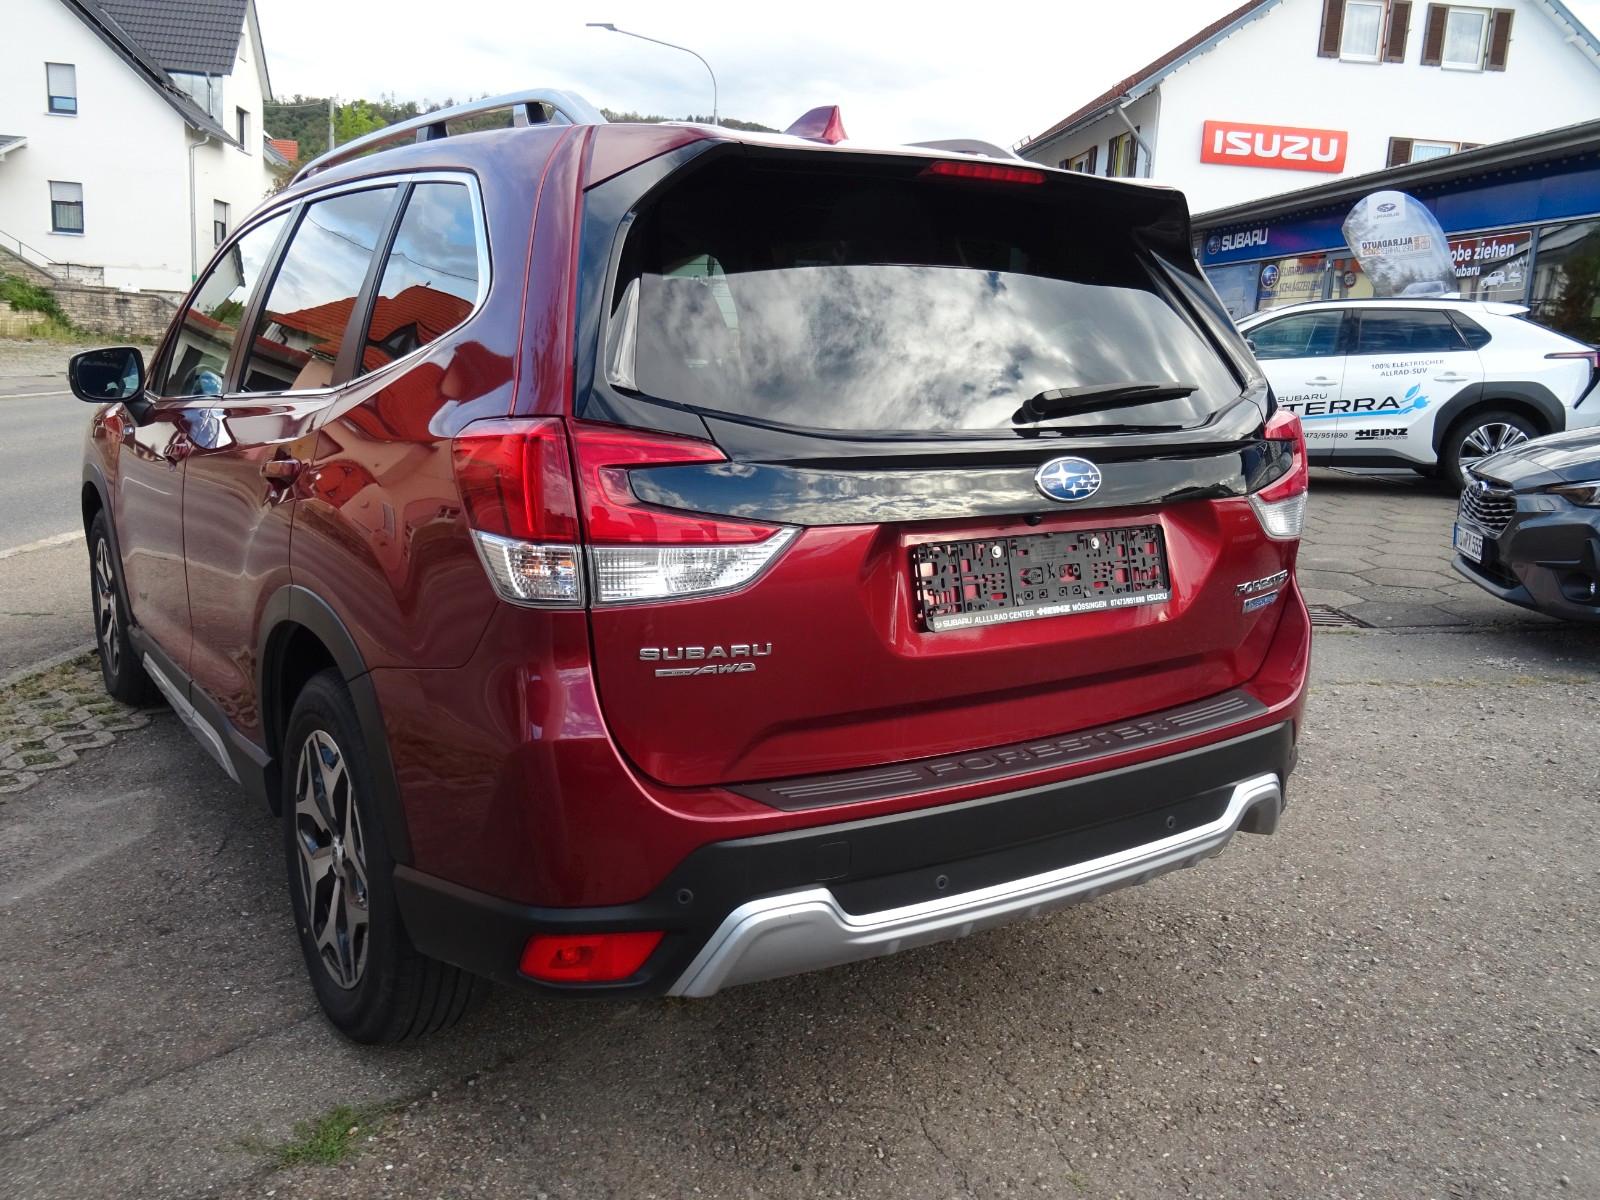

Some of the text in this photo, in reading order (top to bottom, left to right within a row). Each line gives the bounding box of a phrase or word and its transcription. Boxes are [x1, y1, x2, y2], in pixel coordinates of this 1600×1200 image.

[1213, 129, 1339, 162] ISUZU
[1221, 227, 1269, 252] SUBARU
[1473, 239, 1515, 260] ziehen
[1380, 367, 1428, 377] ALLRAD-SUV
[1392, 359, 1445, 368] ELEKTRISCHER
[1277, 393, 1328, 403] SUBARU
[1357, 427, 1408, 437] HEINZ
[942, 616, 973, 629] SUBARU
[1009, 608, 1035, 620] CENTER
[1072, 600, 1107, 612] MÖSSINGEN
[1146, 592, 1168, 602] ISUZU
[639, 643, 772, 661] SUBARU
[693, 662, 756, 676] AWD
[924, 719, 1170, 778] FORESTER
